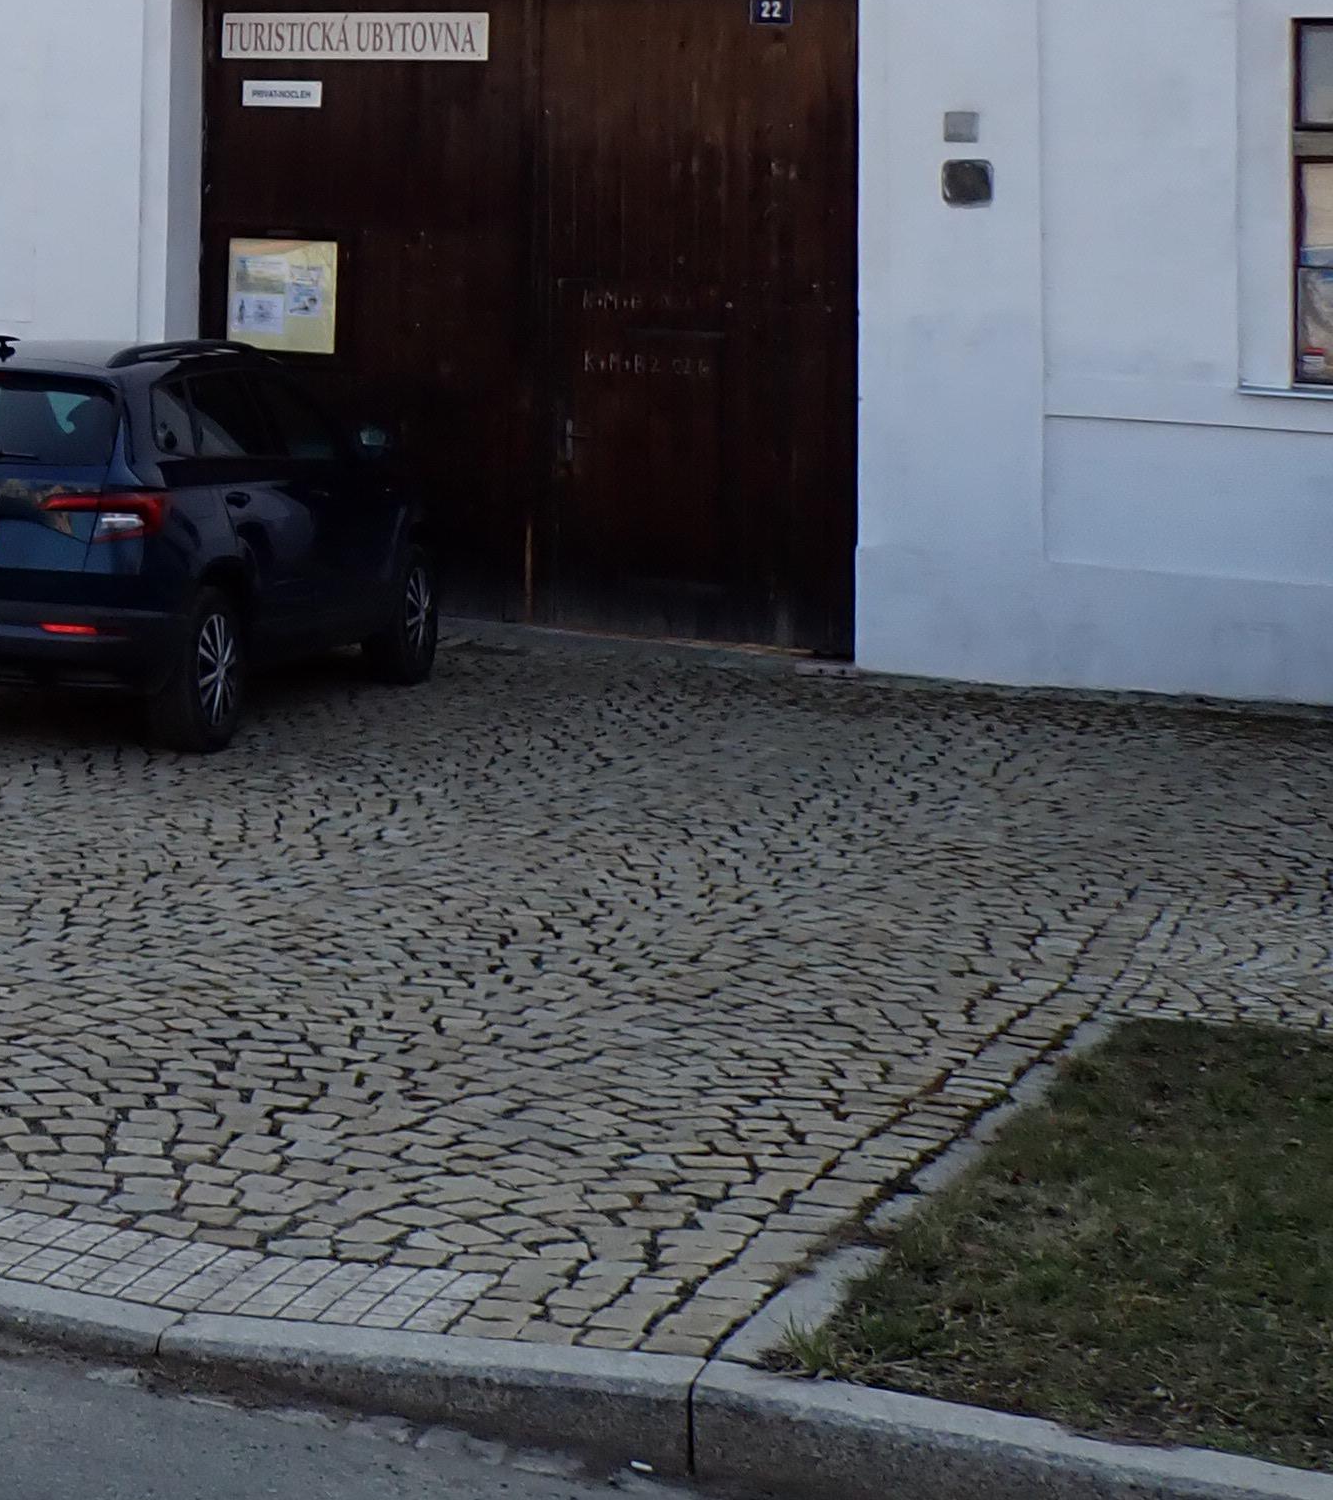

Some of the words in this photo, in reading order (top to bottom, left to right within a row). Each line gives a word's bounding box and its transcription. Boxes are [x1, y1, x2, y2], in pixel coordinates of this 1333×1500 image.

[760, 0, 783, 18] 22
[225, 14, 350, 53] TURISTICKÁ
[356, 21, 476, 53] UBYTOVNA
